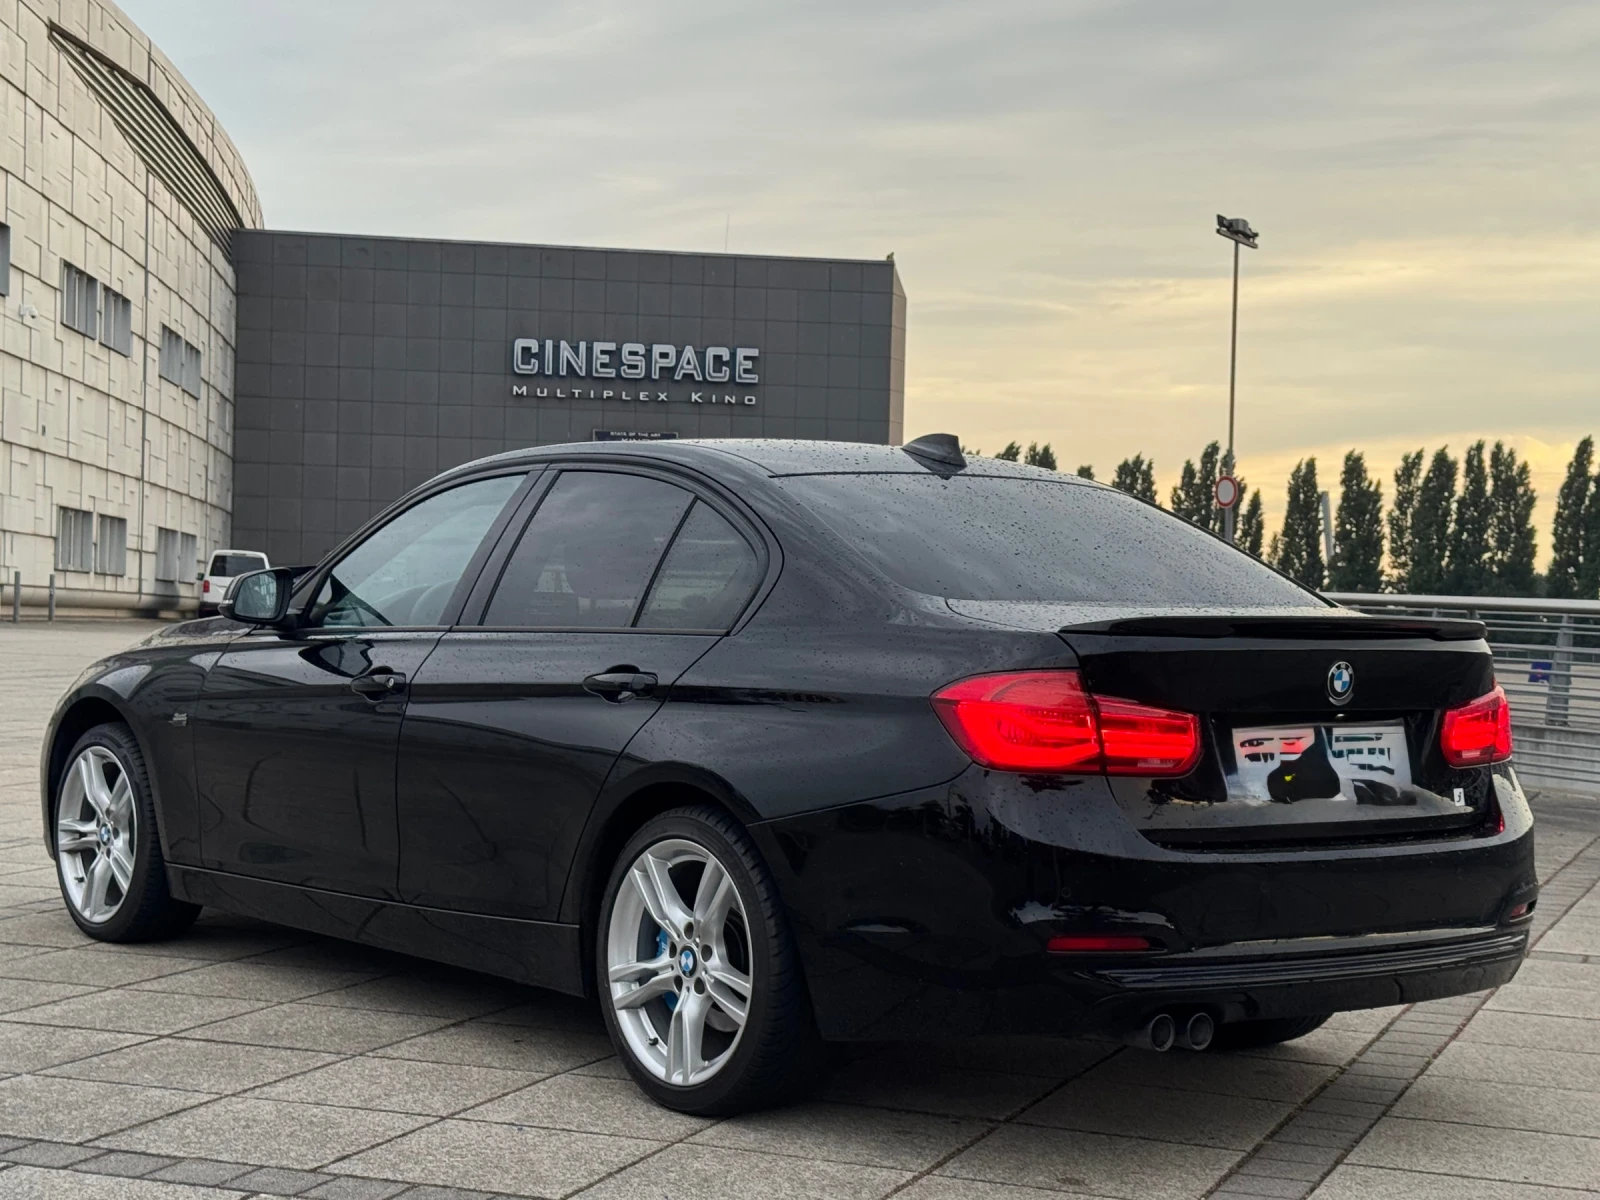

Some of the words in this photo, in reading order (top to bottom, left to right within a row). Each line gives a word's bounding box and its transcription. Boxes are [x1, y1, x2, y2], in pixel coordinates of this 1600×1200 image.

[513, 338, 759, 383] CINESPACE
[513, 385, 668, 401] MULTIPLEX
[691, 392, 756, 405] KINO
